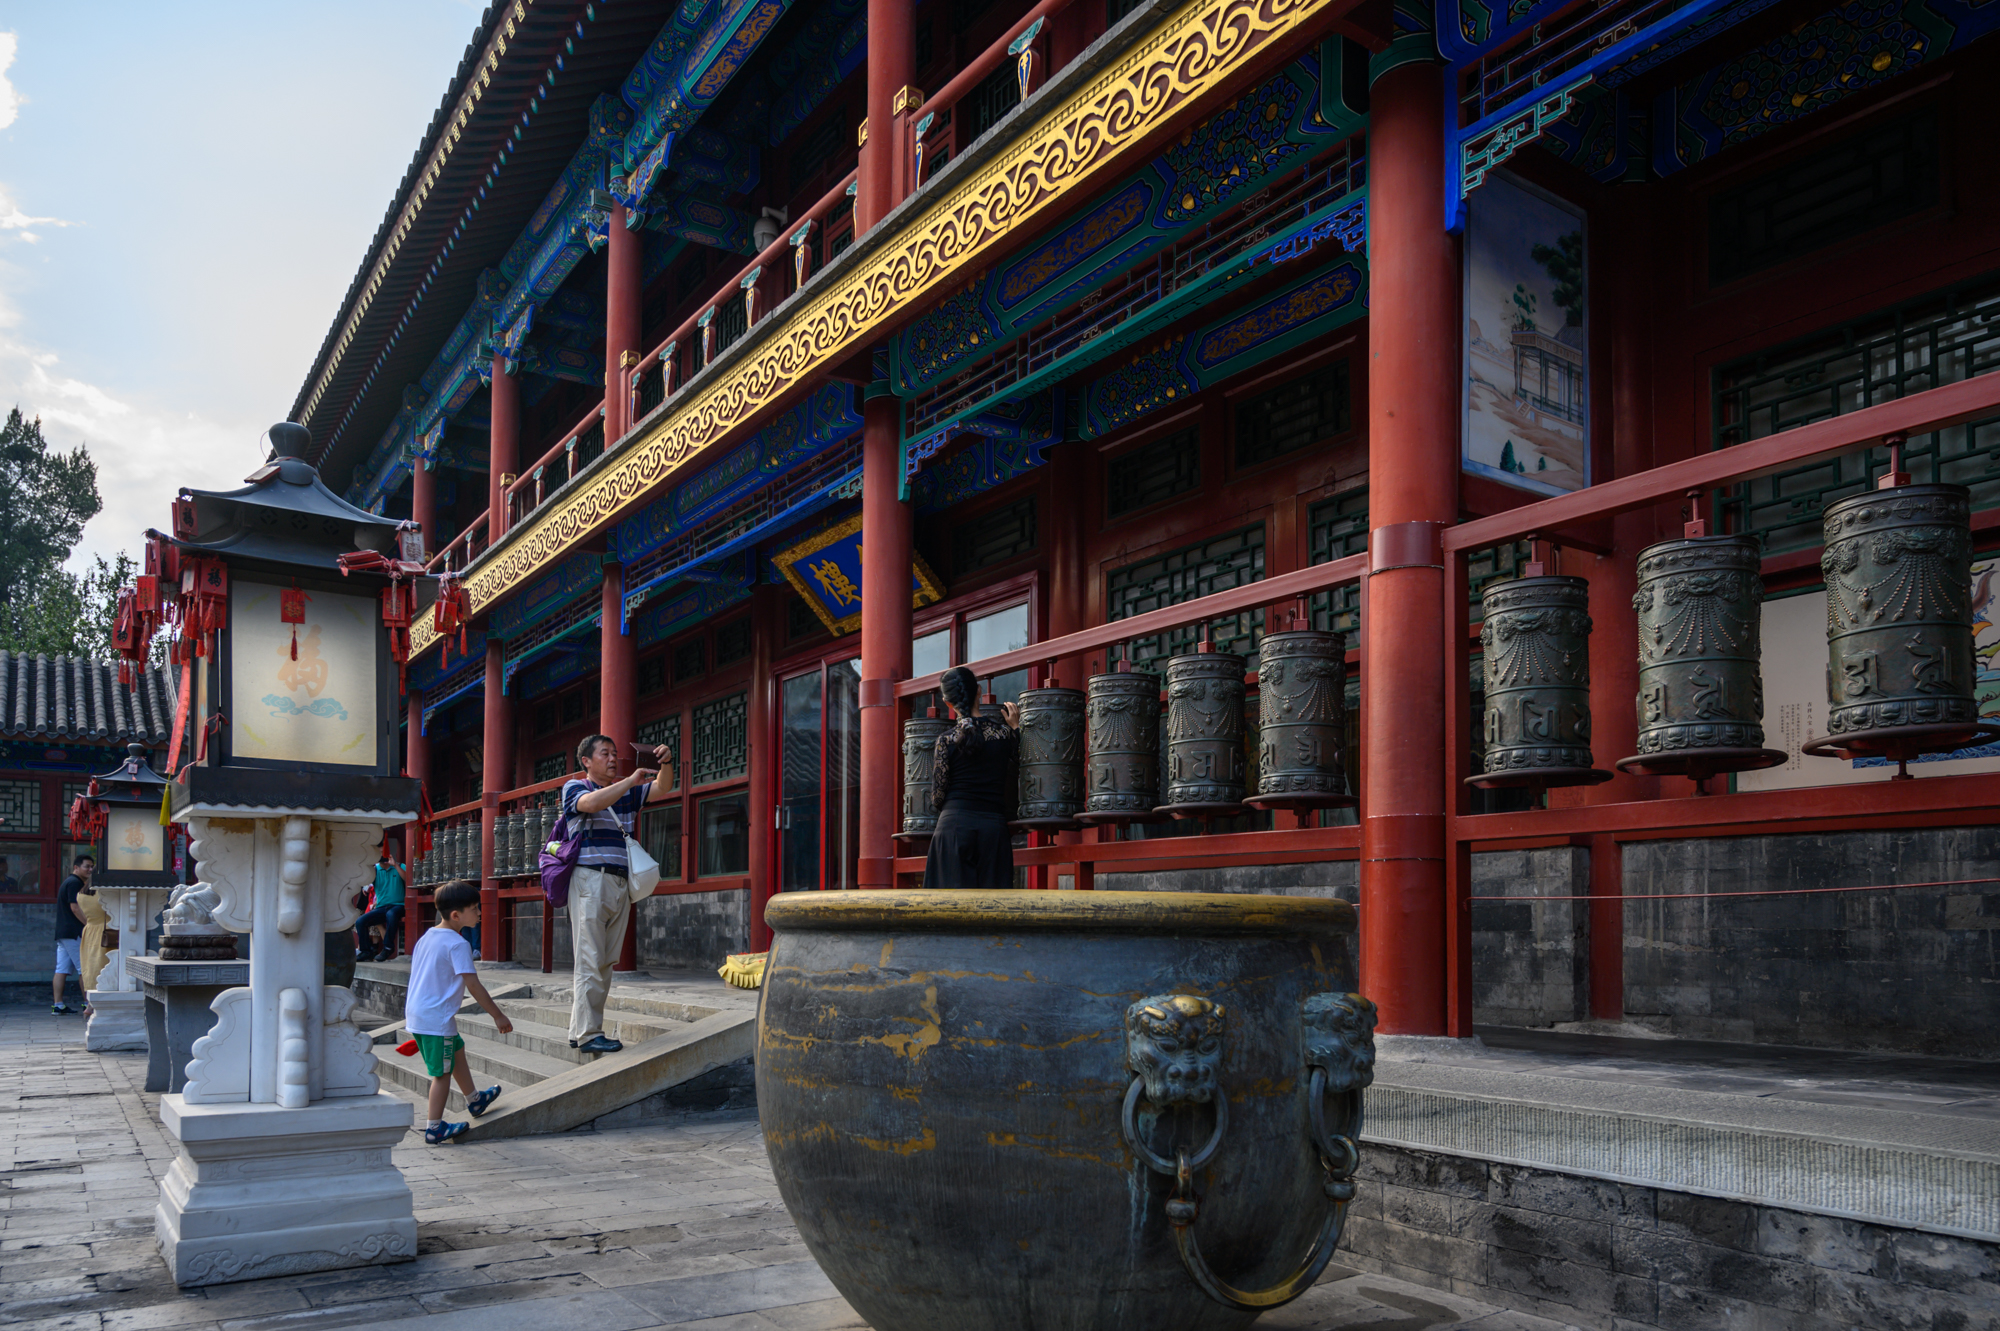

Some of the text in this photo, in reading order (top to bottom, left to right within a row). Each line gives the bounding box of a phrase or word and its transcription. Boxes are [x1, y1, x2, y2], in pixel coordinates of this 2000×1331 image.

[182, 507, 193, 527] 福
[207, 568, 222, 587] 福
[276, 624, 329, 698] 福
[125, 820, 145, 847] 福
[444, 1044, 453, 1060] WAY
